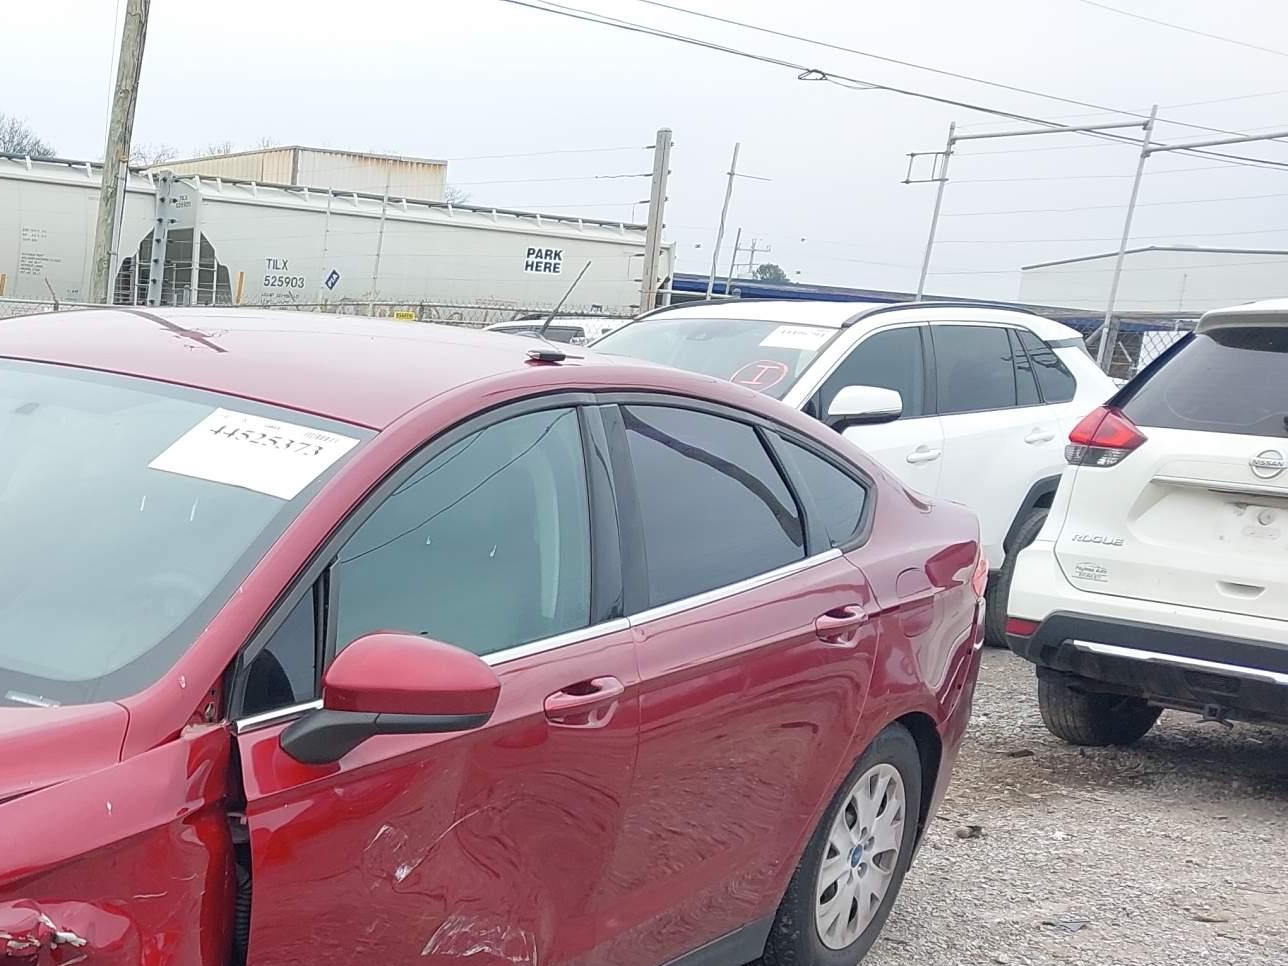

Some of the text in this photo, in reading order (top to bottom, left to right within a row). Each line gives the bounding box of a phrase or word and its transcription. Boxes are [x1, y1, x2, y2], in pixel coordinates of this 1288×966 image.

[526, 247, 563, 261] PARK
[266, 258, 288, 271] TILX
[524, 260, 561, 274] HERE
[263, 275, 305, 289] 525903
[209, 425, 324, 456] 44525373
[1072, 534, 1124, 547] ROGUE
